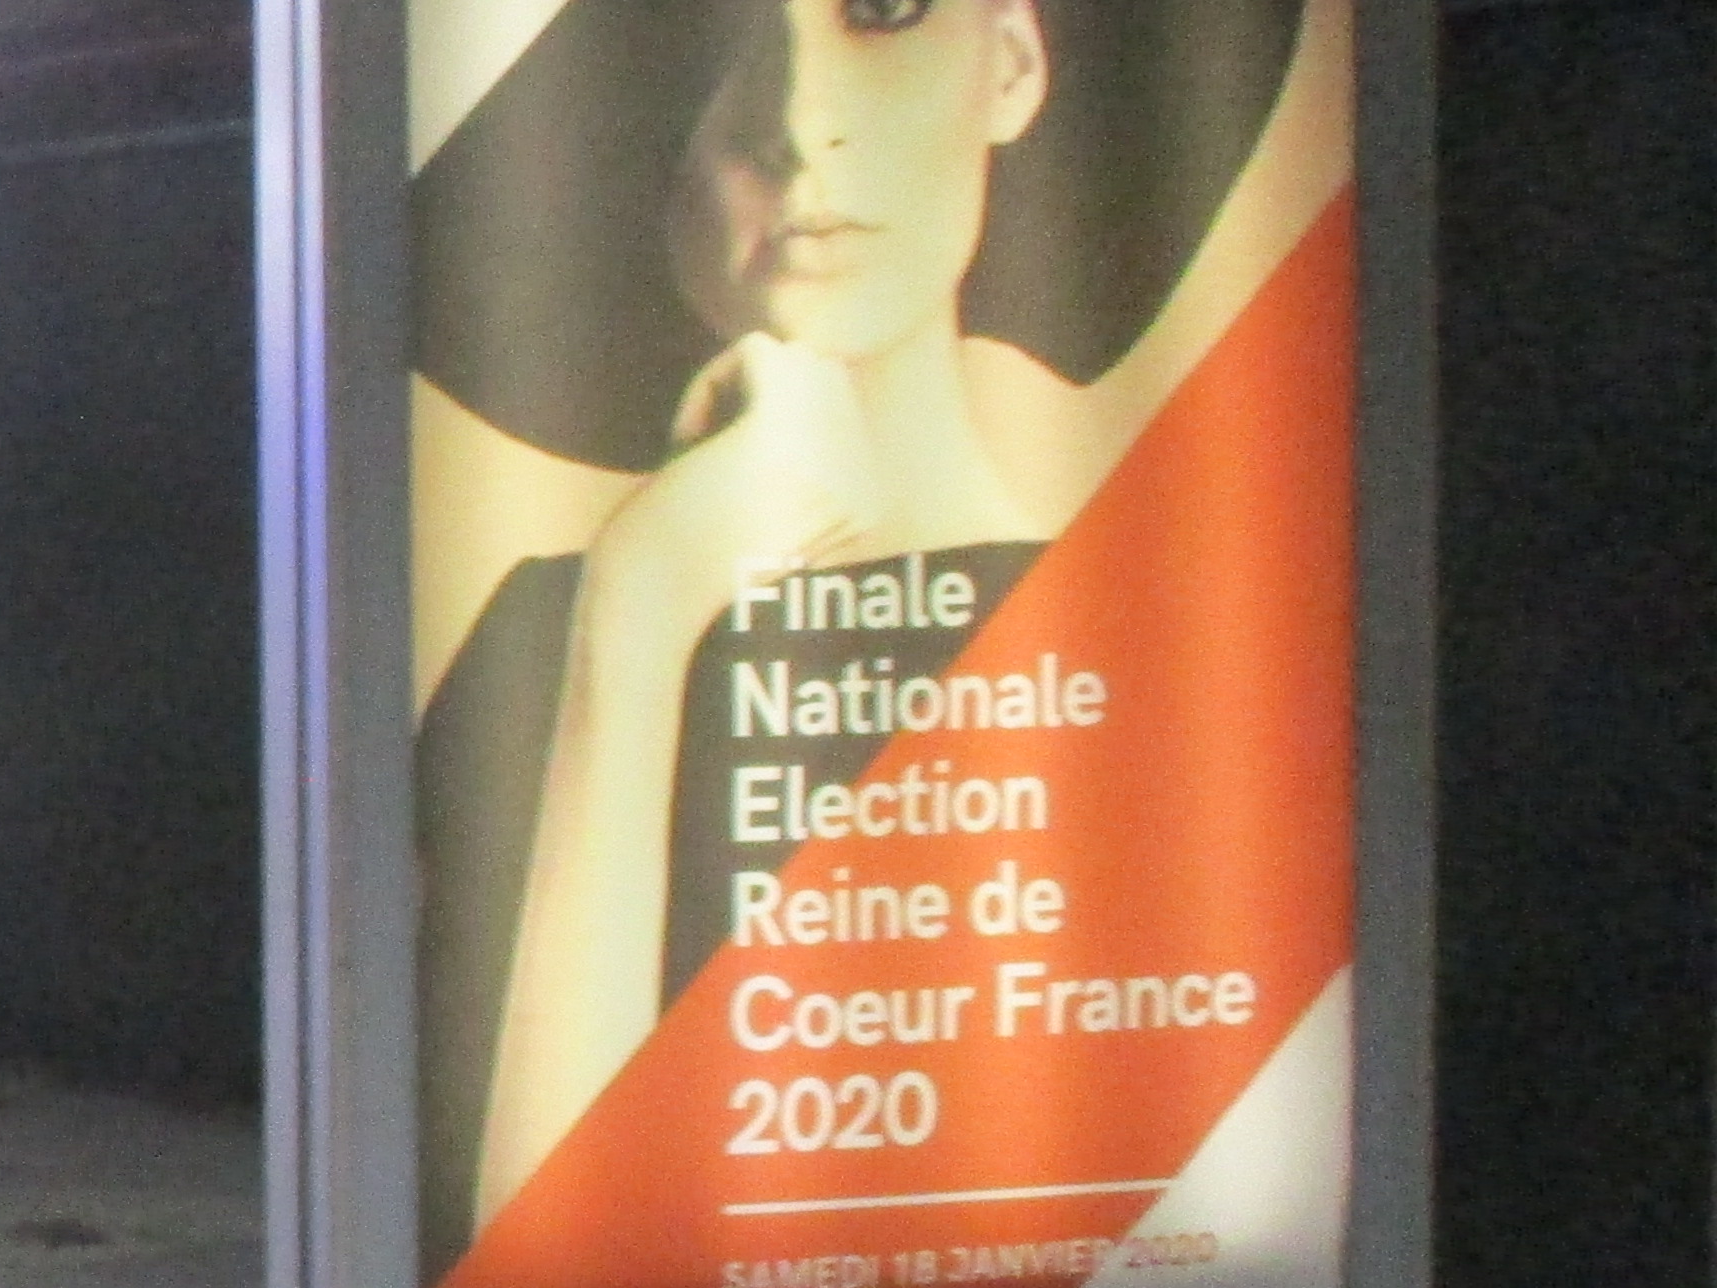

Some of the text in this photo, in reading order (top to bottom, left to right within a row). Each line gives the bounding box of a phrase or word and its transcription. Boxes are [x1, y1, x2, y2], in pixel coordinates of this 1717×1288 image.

[729, 552, 977, 631] Finale
[729, 652, 1108, 737] Nationale
[729, 760, 1048, 843] Election
[729, 860, 1066, 947] Reine de
[727, 961, 1257, 1051] Coeur France
[723, 1070, 939, 1155] 2020
[893, 1248, 938, 1286] 18
